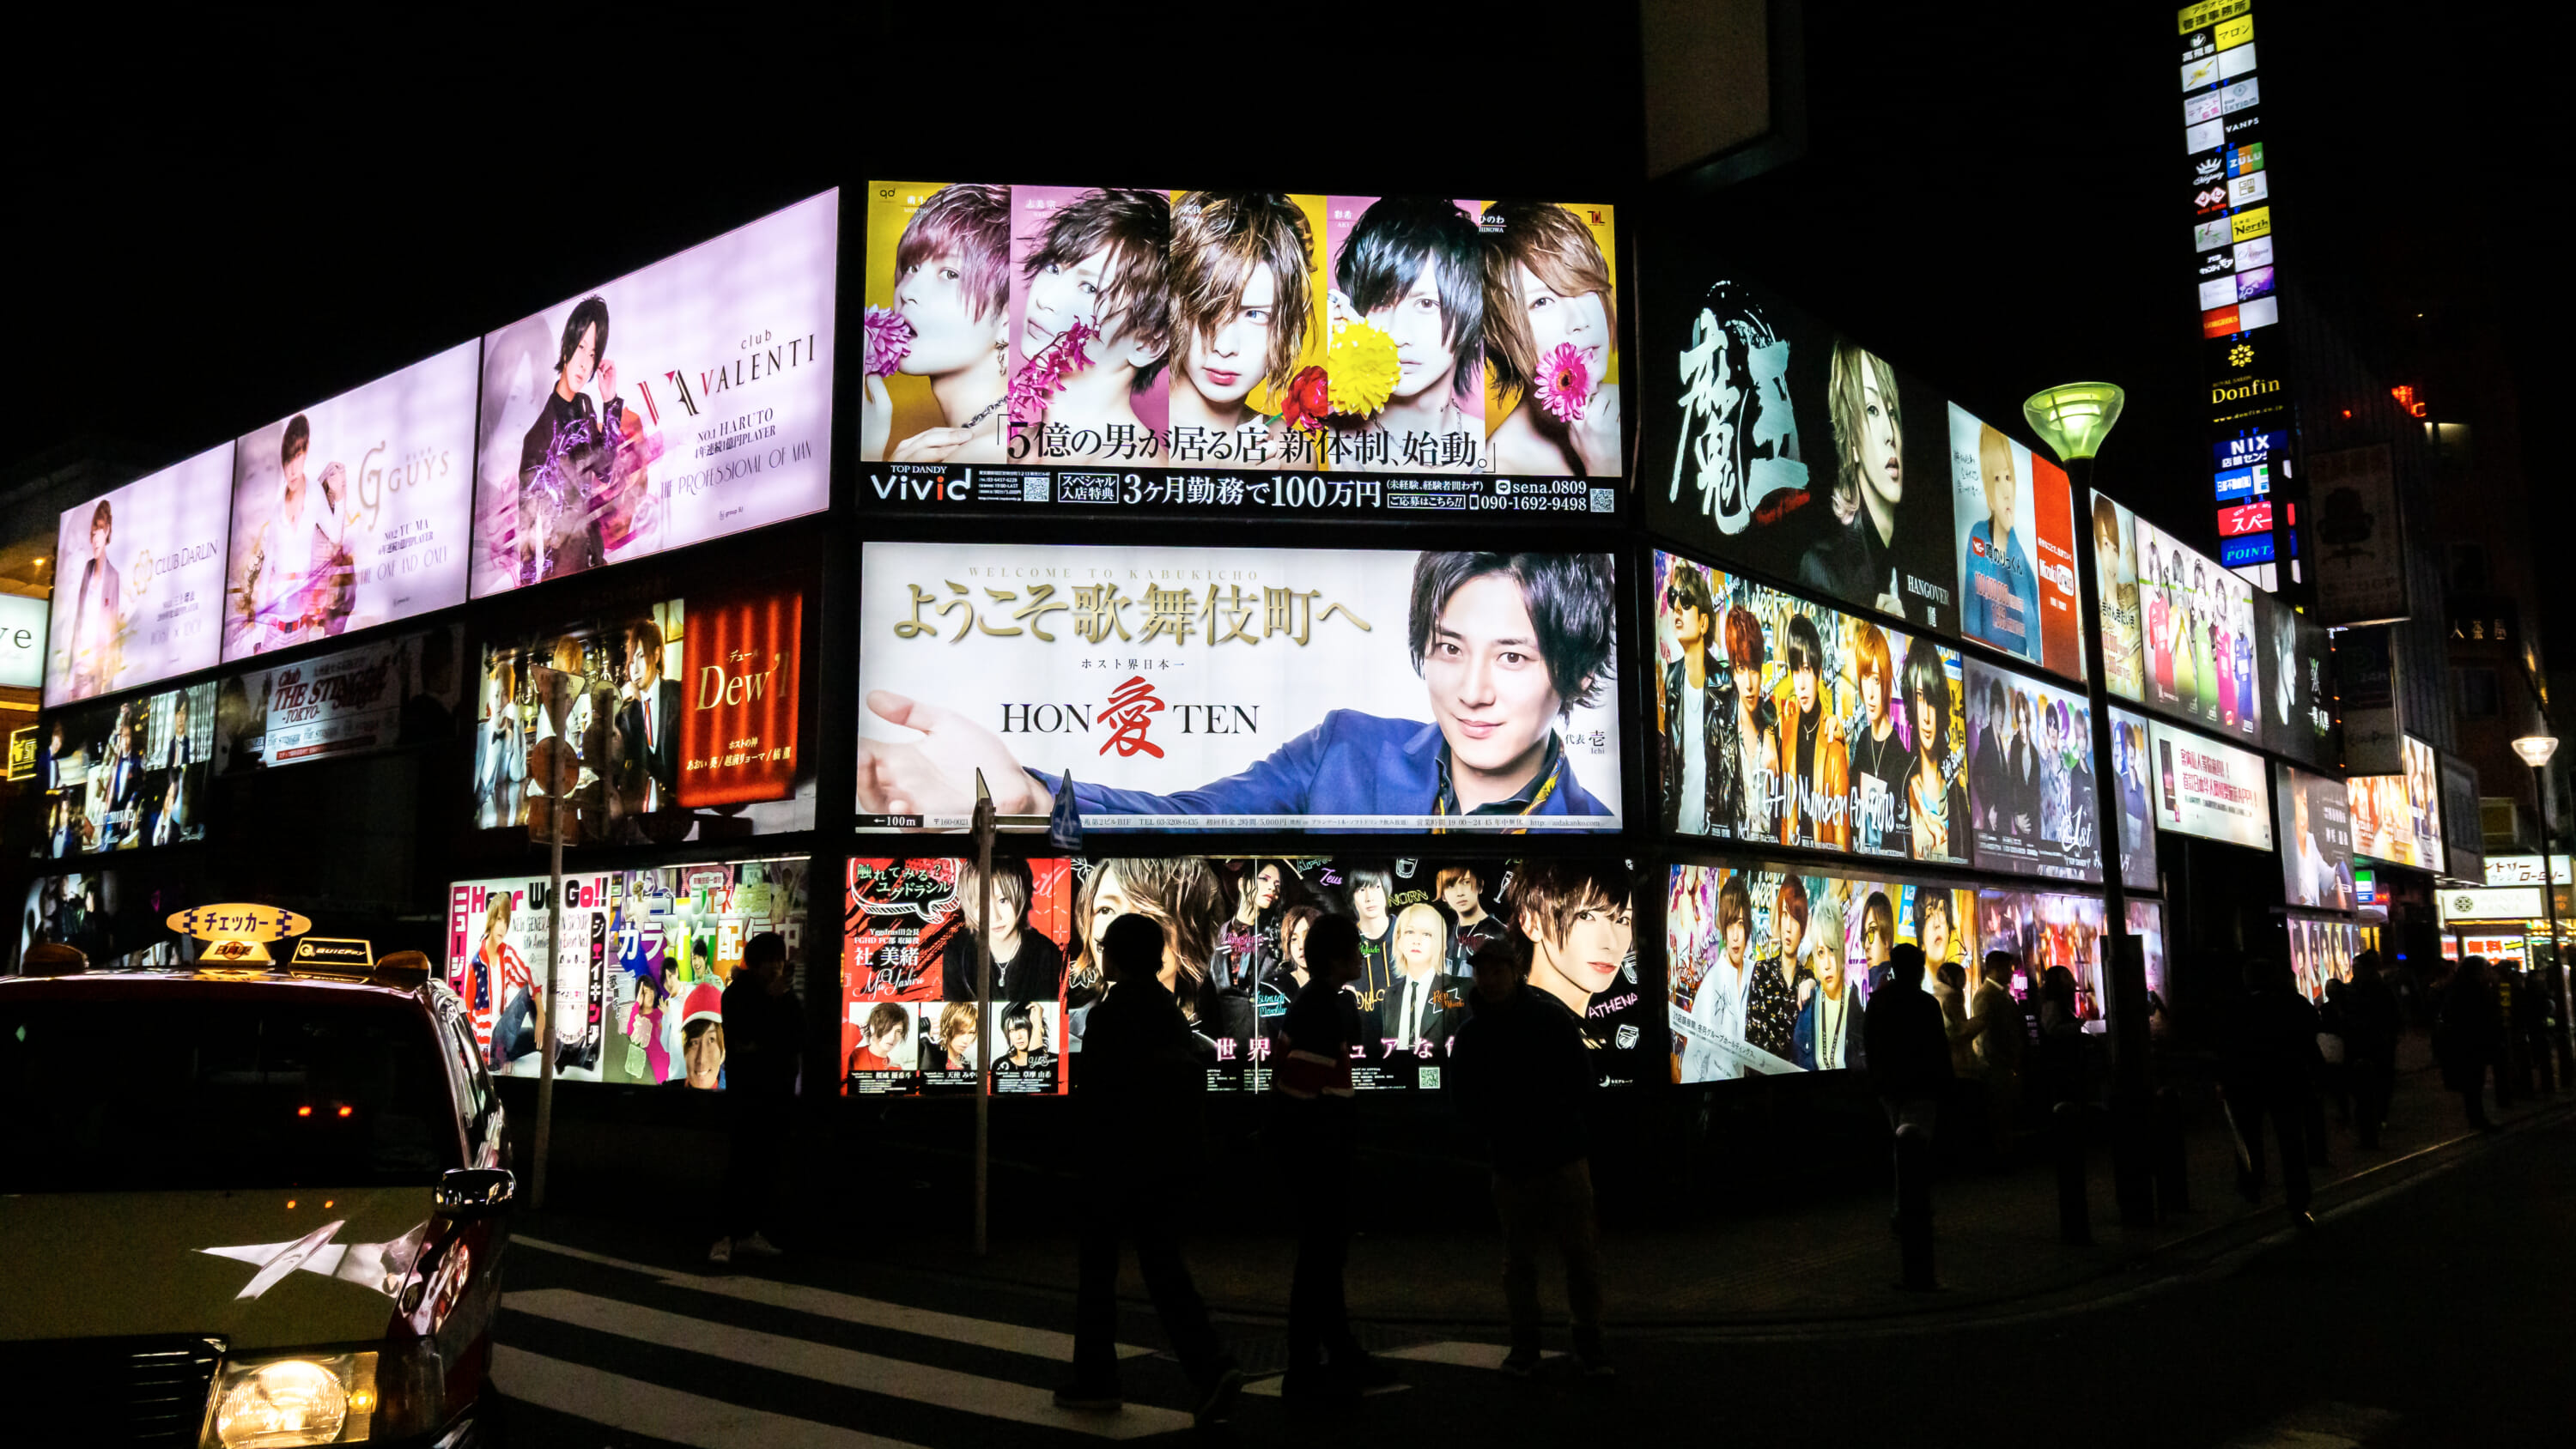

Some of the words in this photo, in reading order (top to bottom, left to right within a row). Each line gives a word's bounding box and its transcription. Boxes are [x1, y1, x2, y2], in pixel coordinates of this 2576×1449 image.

[1479, 215, 1504, 224] ひのわ
[741, 330, 772, 349] club
[701, 334, 815, 397] VALENTI
[2212, 379, 2281, 404] Donfin
[720, 407, 773, 436] HARUTO
[2231, 434, 2269, 455] NIX
[678, 453, 762, 495] PROFESSIONAL
[769, 446, 787, 469] OF
[792, 439, 811, 464] MAN
[1061, 476, 1115, 487] スペシャル
[1513, 481, 1587, 495] sena.0809
[1061, 488, 1115, 500] 入店特典
[1481, 494, 1587, 512] 090-1692-9498
[155, 553, 179, 576] CLUB
[180, 539, 219, 567] DARLIN
[2227, 545, 2271, 561] POINT
[969, 567, 1071, 578] WELCOME
[1090, 568, 1113, 579] TO
[1129, 568, 1258, 580] KABUKICHO
[1906, 574, 1950, 606] HANGOVER
[894, 579, 1371, 646] ようこそ歌舞伎町へ
[1081, 658, 1185, 670] ホスト界日本一
[278, 667, 301, 688] Club
[273, 683, 308, 712] THE
[282, 705, 321, 724] -TOKYO-
[1000, 704, 1092, 732] HON
[1097, 676, 1165, 759] 愛
[1173, 705, 1260, 734] TEN
[886, 816, 916, 826] 100m
[1319, 867, 1343, 887] Zeus
[564, 876, 609, 909] Go!!
[876, 881, 952, 901] ユグドラシル
[1388, 889, 1430, 907] NORN
[204, 912, 269, 932] チェッカー
[1588, 992, 1638, 1019] ATHENA
